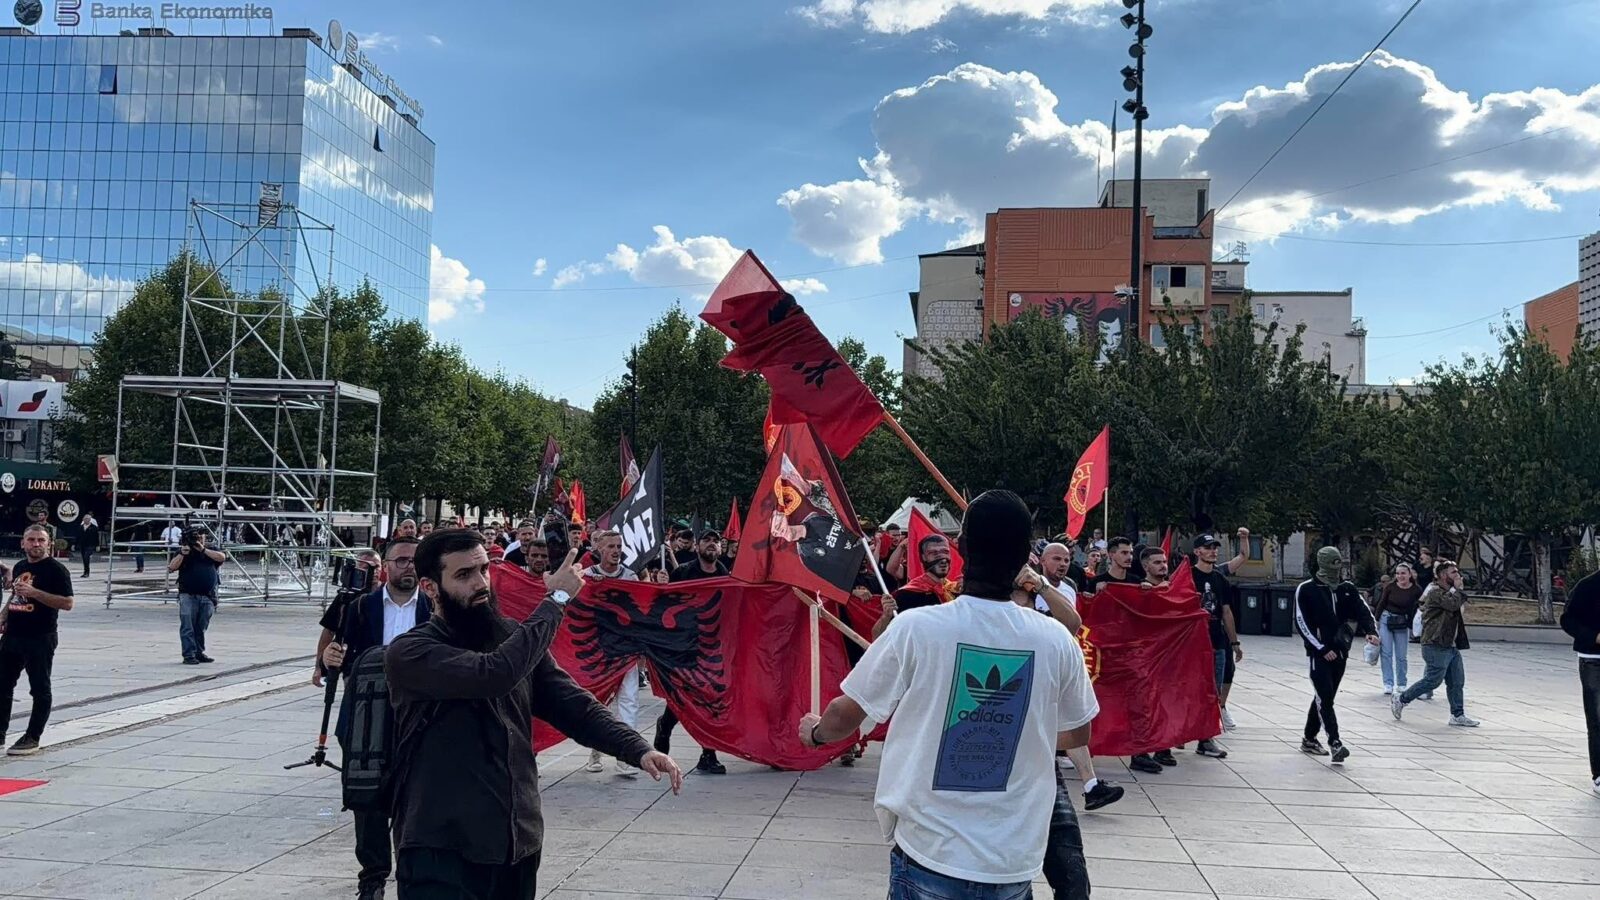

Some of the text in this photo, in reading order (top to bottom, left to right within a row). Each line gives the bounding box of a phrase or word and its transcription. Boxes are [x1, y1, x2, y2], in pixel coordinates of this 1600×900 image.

[90, 2, 273, 20] Banka Ekonomike
[28, 479, 71, 492] LOKANTA
[958, 708, 1014, 724] adidas
